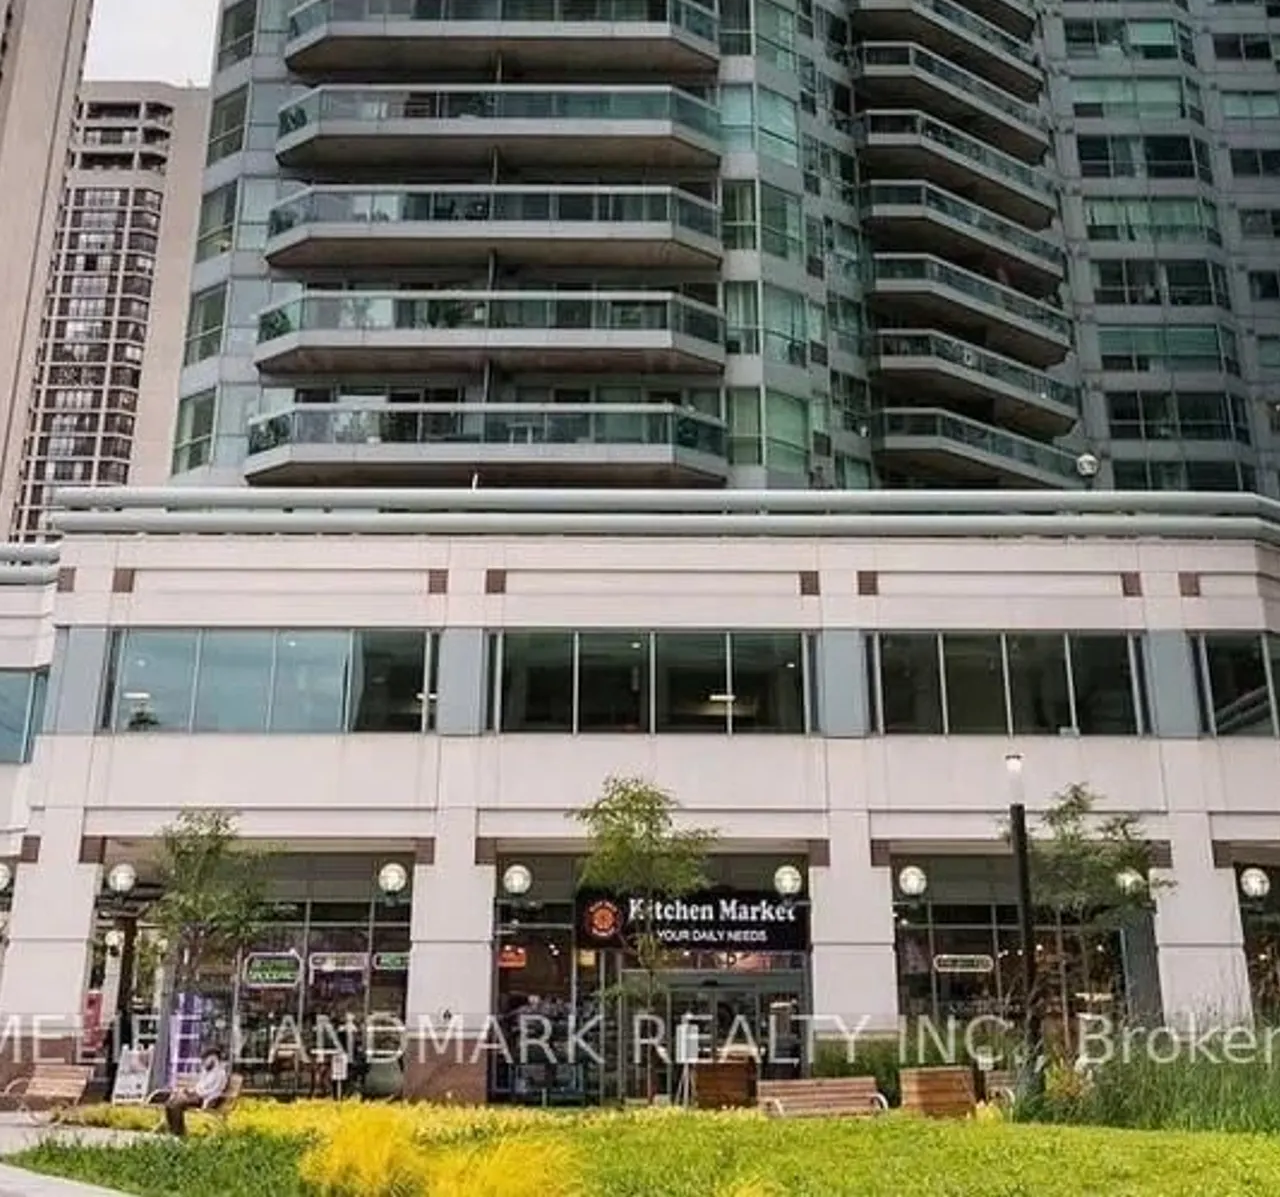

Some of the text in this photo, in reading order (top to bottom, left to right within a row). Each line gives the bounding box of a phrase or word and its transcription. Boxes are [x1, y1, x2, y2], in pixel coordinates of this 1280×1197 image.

[629, 898, 714, 921] Kitchen
[719, 899, 796, 921] Market
[657, 929, 769, 942] YOUR DAILY NEEDS
